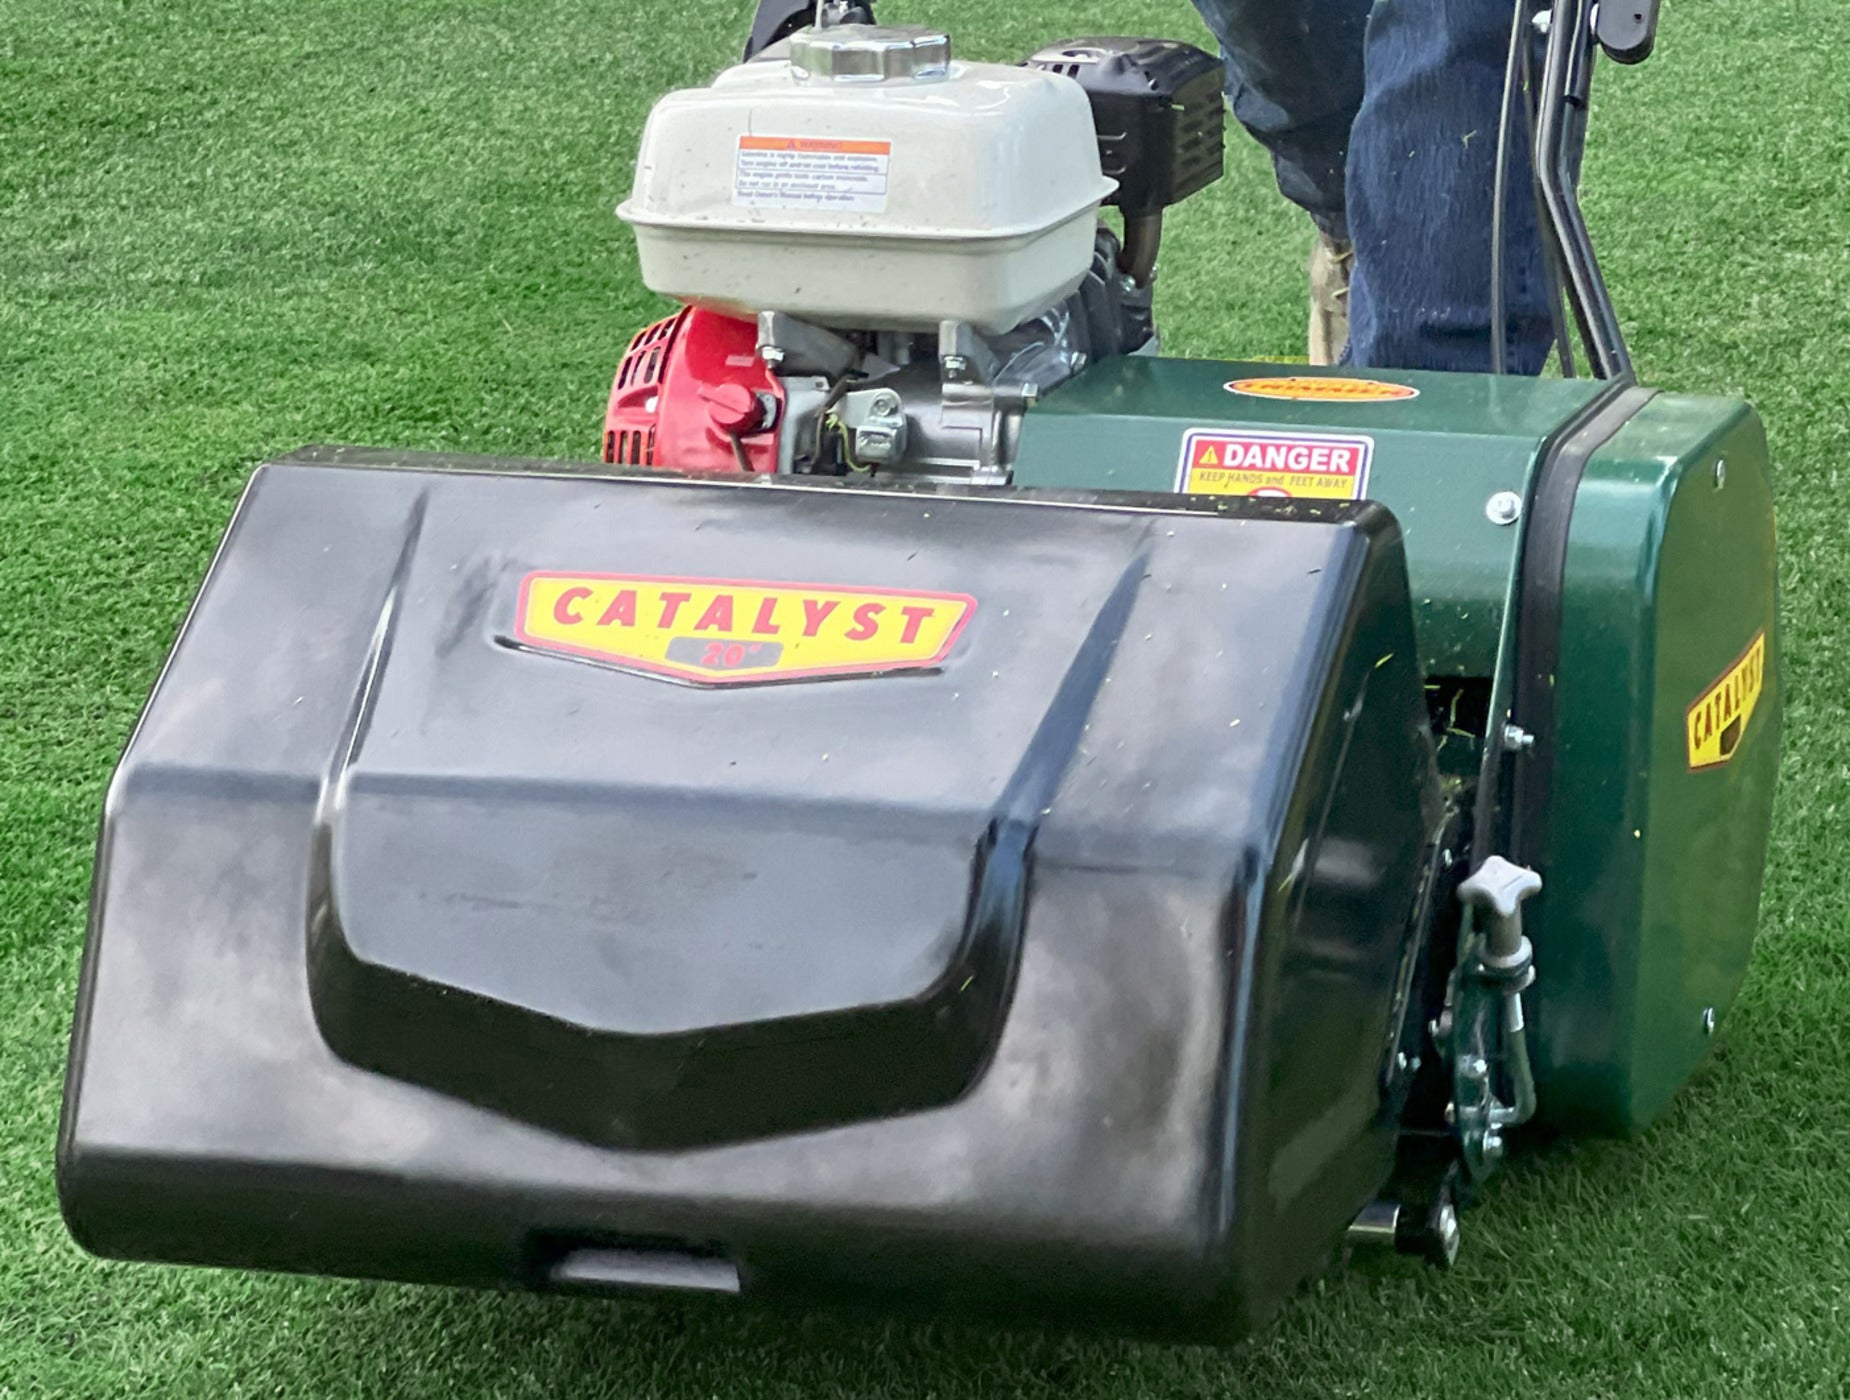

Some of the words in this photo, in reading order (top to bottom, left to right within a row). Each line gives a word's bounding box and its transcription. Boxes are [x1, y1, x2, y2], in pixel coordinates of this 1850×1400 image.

[1222, 443, 1351, 472] DANGER
[1199, 471, 1226, 482] KEEP
[1226, 472, 1263, 484] HANDS
[1265, 475, 1285, 486] and
[1289, 475, 1314, 487] FEET
[1316, 477, 1348, 489] AWAY
[551, 586, 935, 644] CATALYST
[1694, 646, 1762, 750] CATALYST
